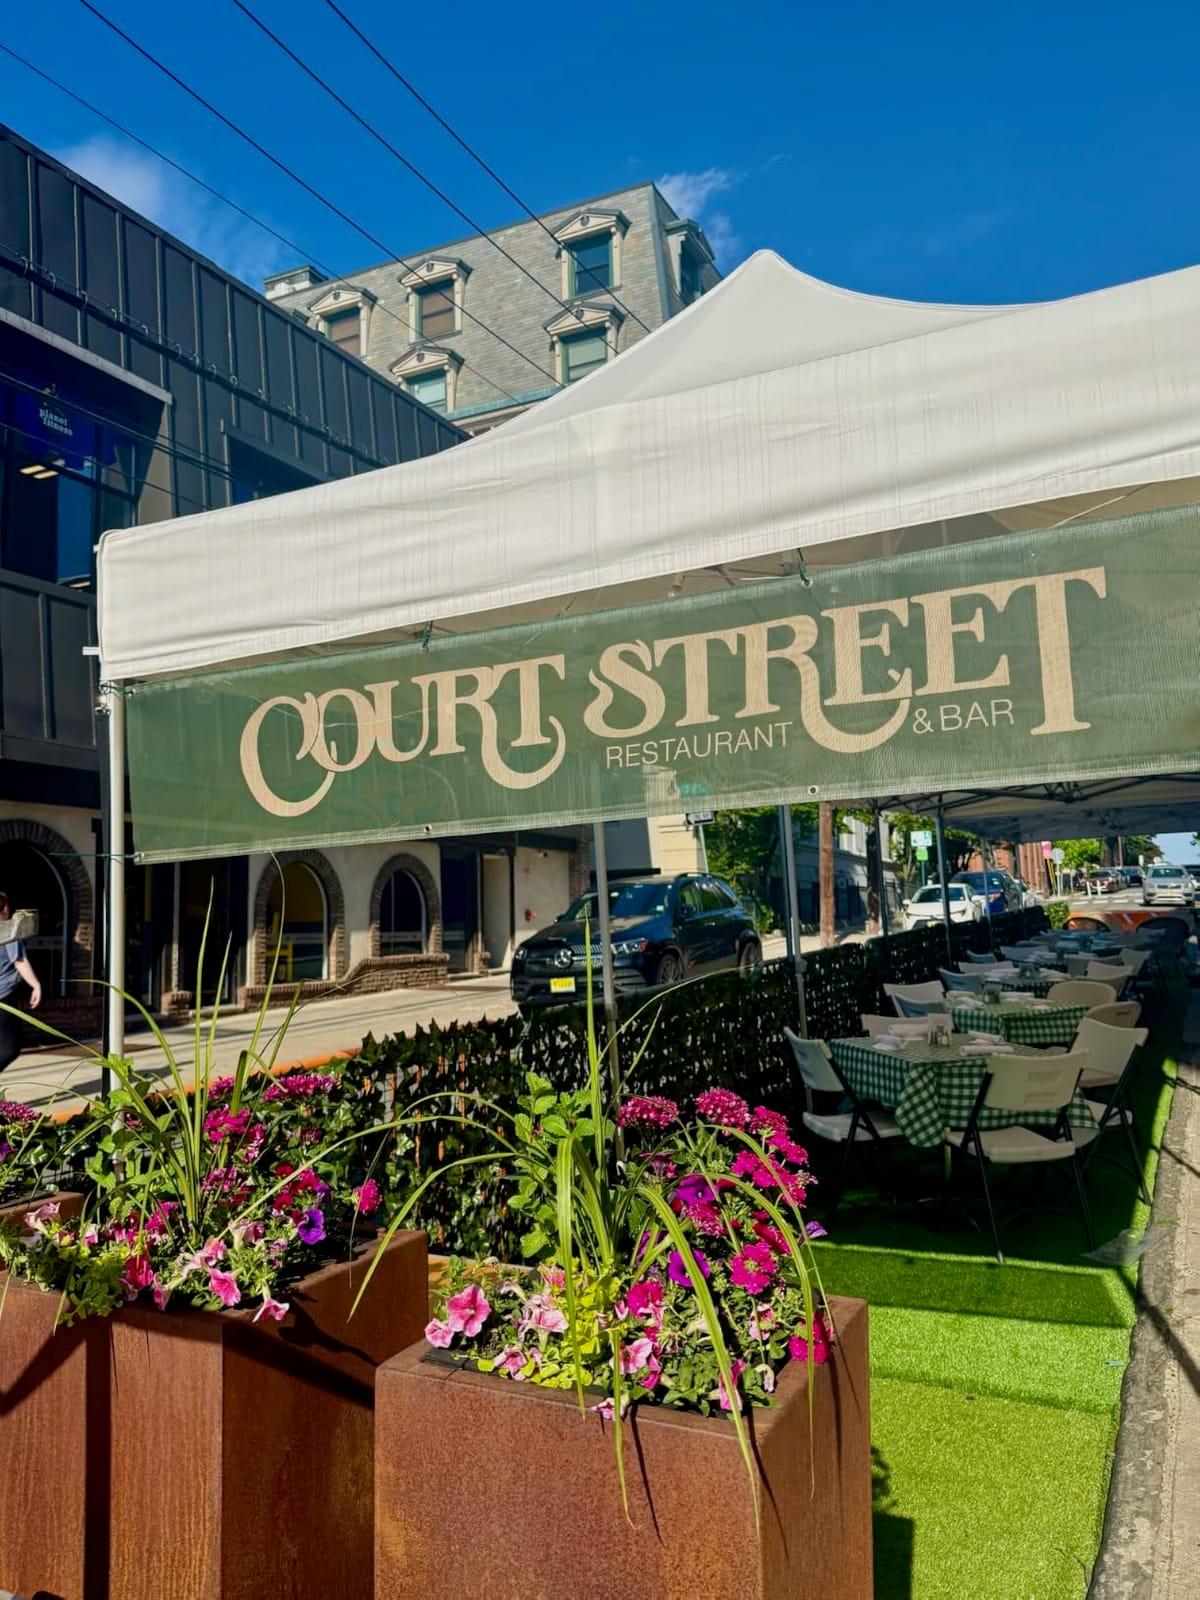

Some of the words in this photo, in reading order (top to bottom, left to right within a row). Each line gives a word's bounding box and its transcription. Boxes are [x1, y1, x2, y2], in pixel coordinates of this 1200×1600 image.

[39, 408, 68, 426] planet
[43, 416, 73, 436] fitness
[239, 654, 566, 817] COURT
[583, 566, 1107, 753] STREET
[606, 721, 793, 769] RESTAURANT
